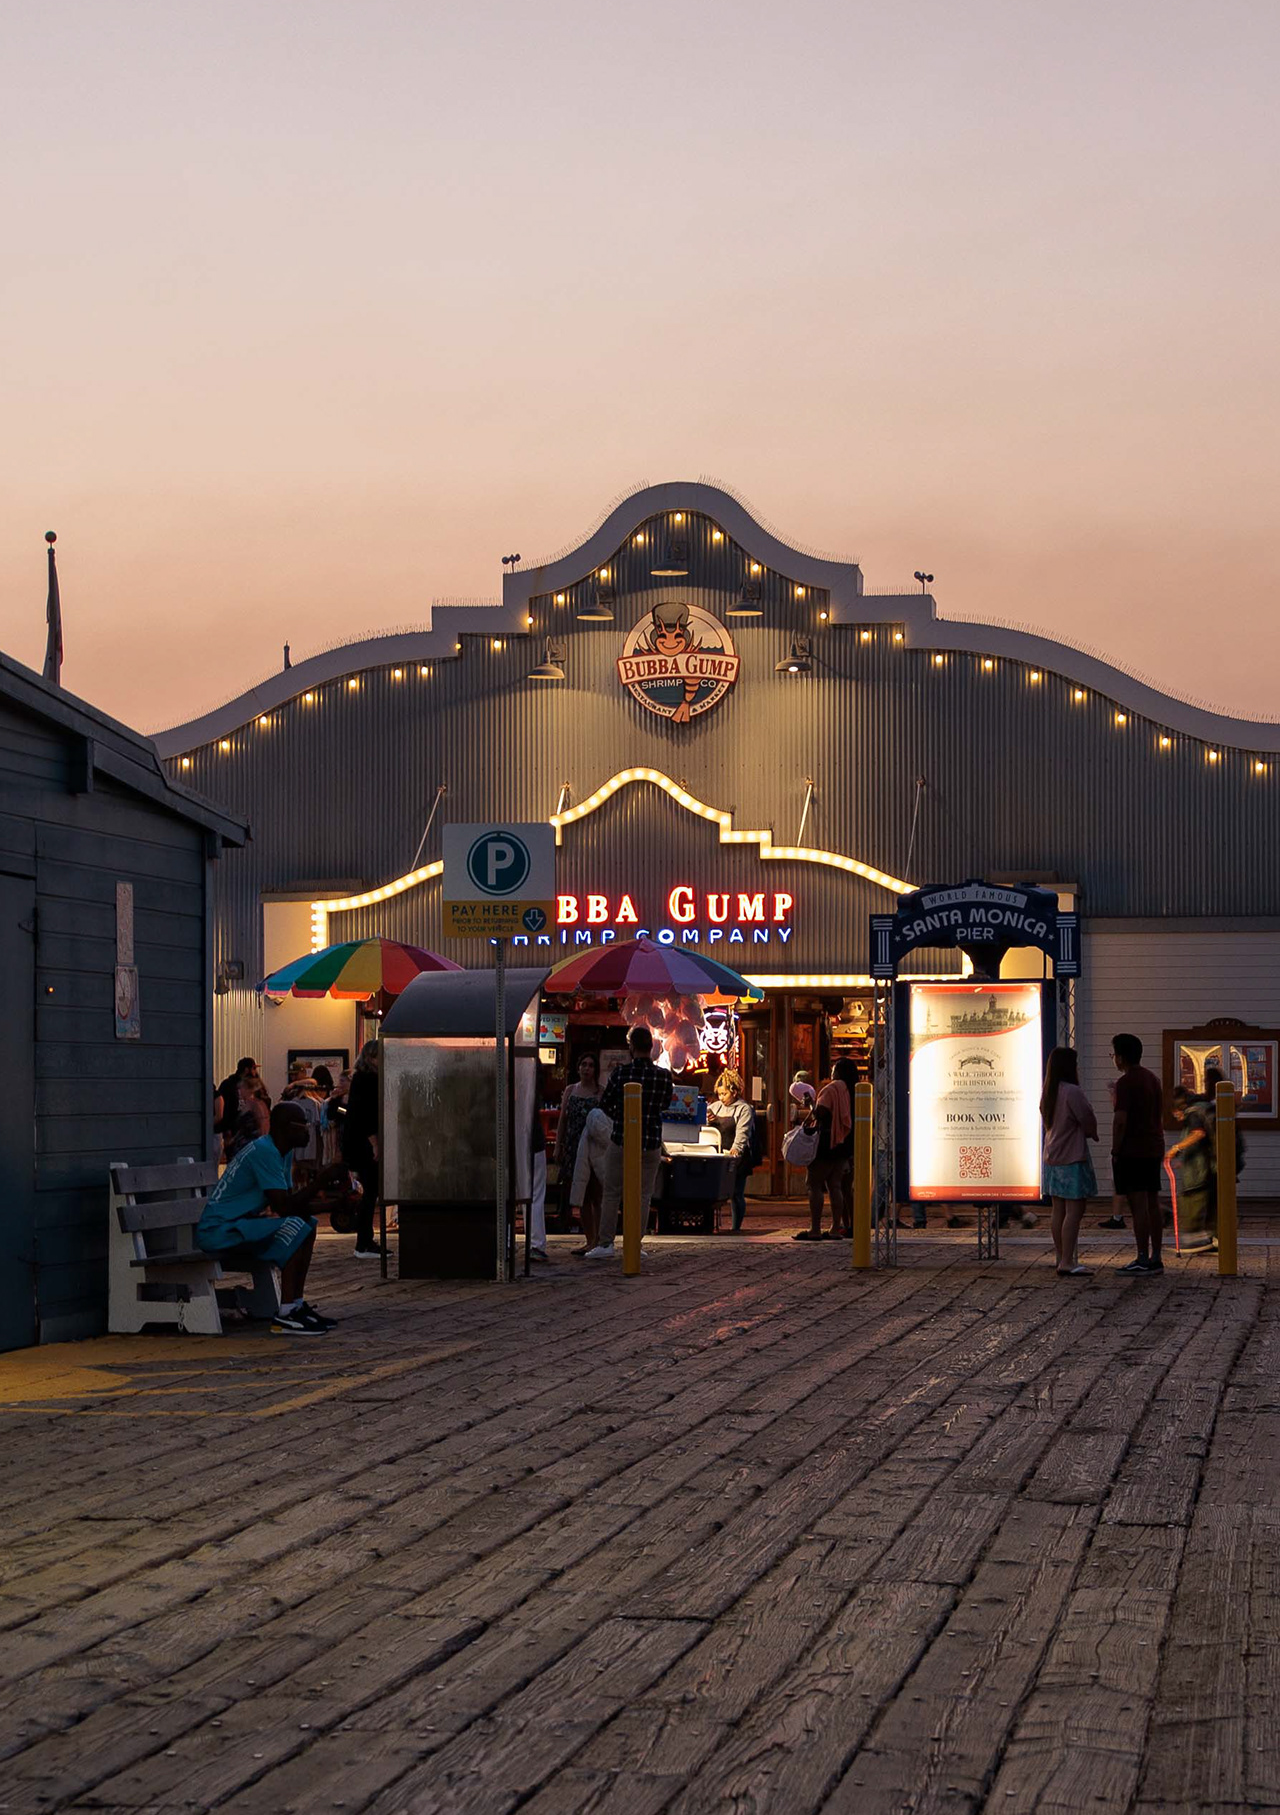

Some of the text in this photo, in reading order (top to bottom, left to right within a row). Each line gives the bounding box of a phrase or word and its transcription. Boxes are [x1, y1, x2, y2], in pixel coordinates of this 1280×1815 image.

[622, 654, 735, 680] BUBBA GUMP
[641, 679, 717, 690] SHRIMP CO
[631, 683, 673, 715] RESTAURANT
[700, 684, 726, 710] MARKET
[487, 841, 515, 886] P
[556, 886, 793, 923] BBA GUMP
[928, 890, 1019, 905] WORLD FAMOUS
[451, 905, 519, 916] PAY HERE
[901, 907, 1048, 942] SANTA MONICA
[955, 927, 995, 941] PIER
[946, 1113, 1006, 1123] BOOK NOW!
